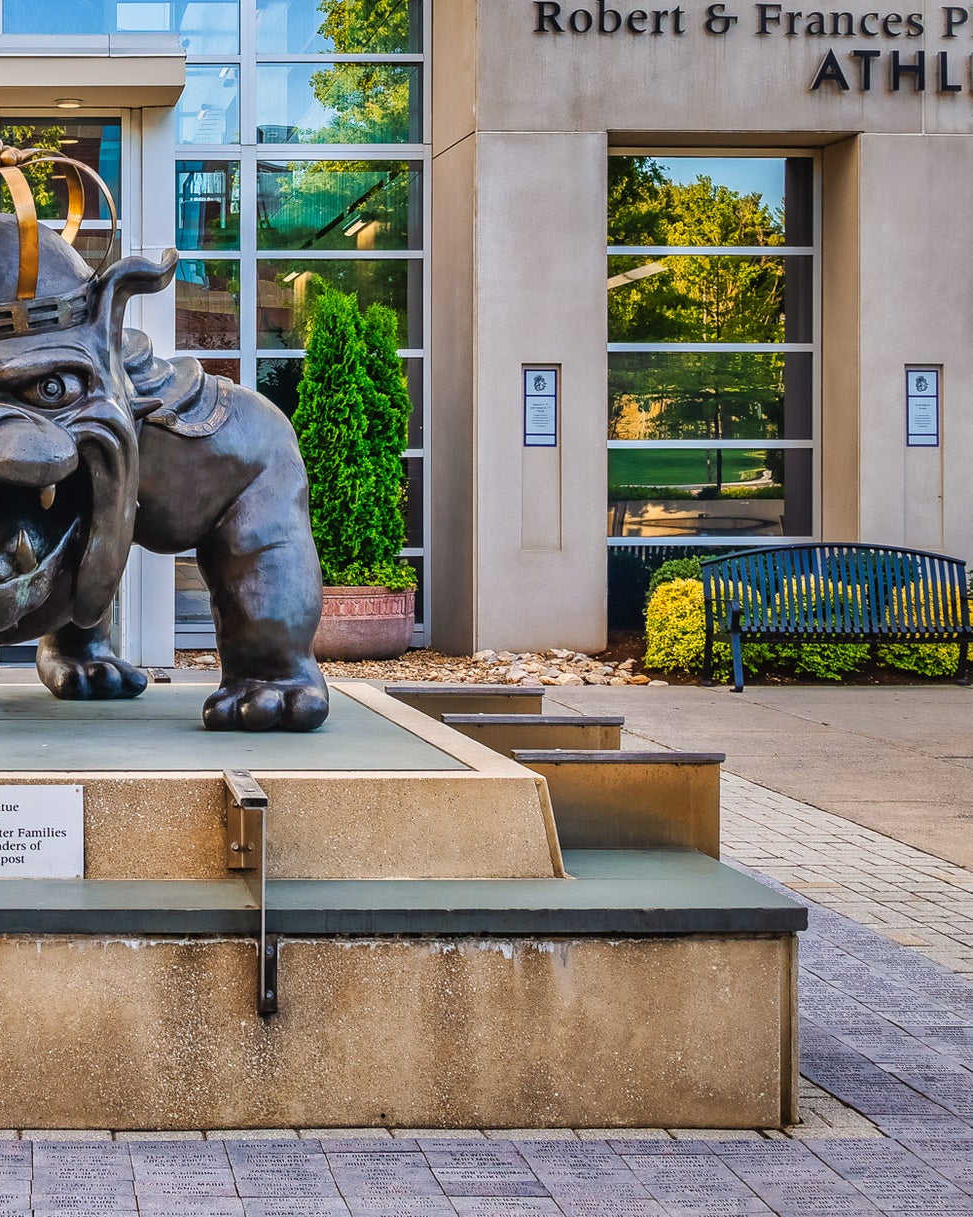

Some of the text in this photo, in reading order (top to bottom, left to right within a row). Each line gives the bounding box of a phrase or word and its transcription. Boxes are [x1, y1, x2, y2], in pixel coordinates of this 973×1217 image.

[705, 3, 738, 34] &
[754, 3, 923, 37] Frances
[809, 48, 973, 92] ATHL
[18, 827, 66, 838] Families
[30, 840, 42, 850] of
